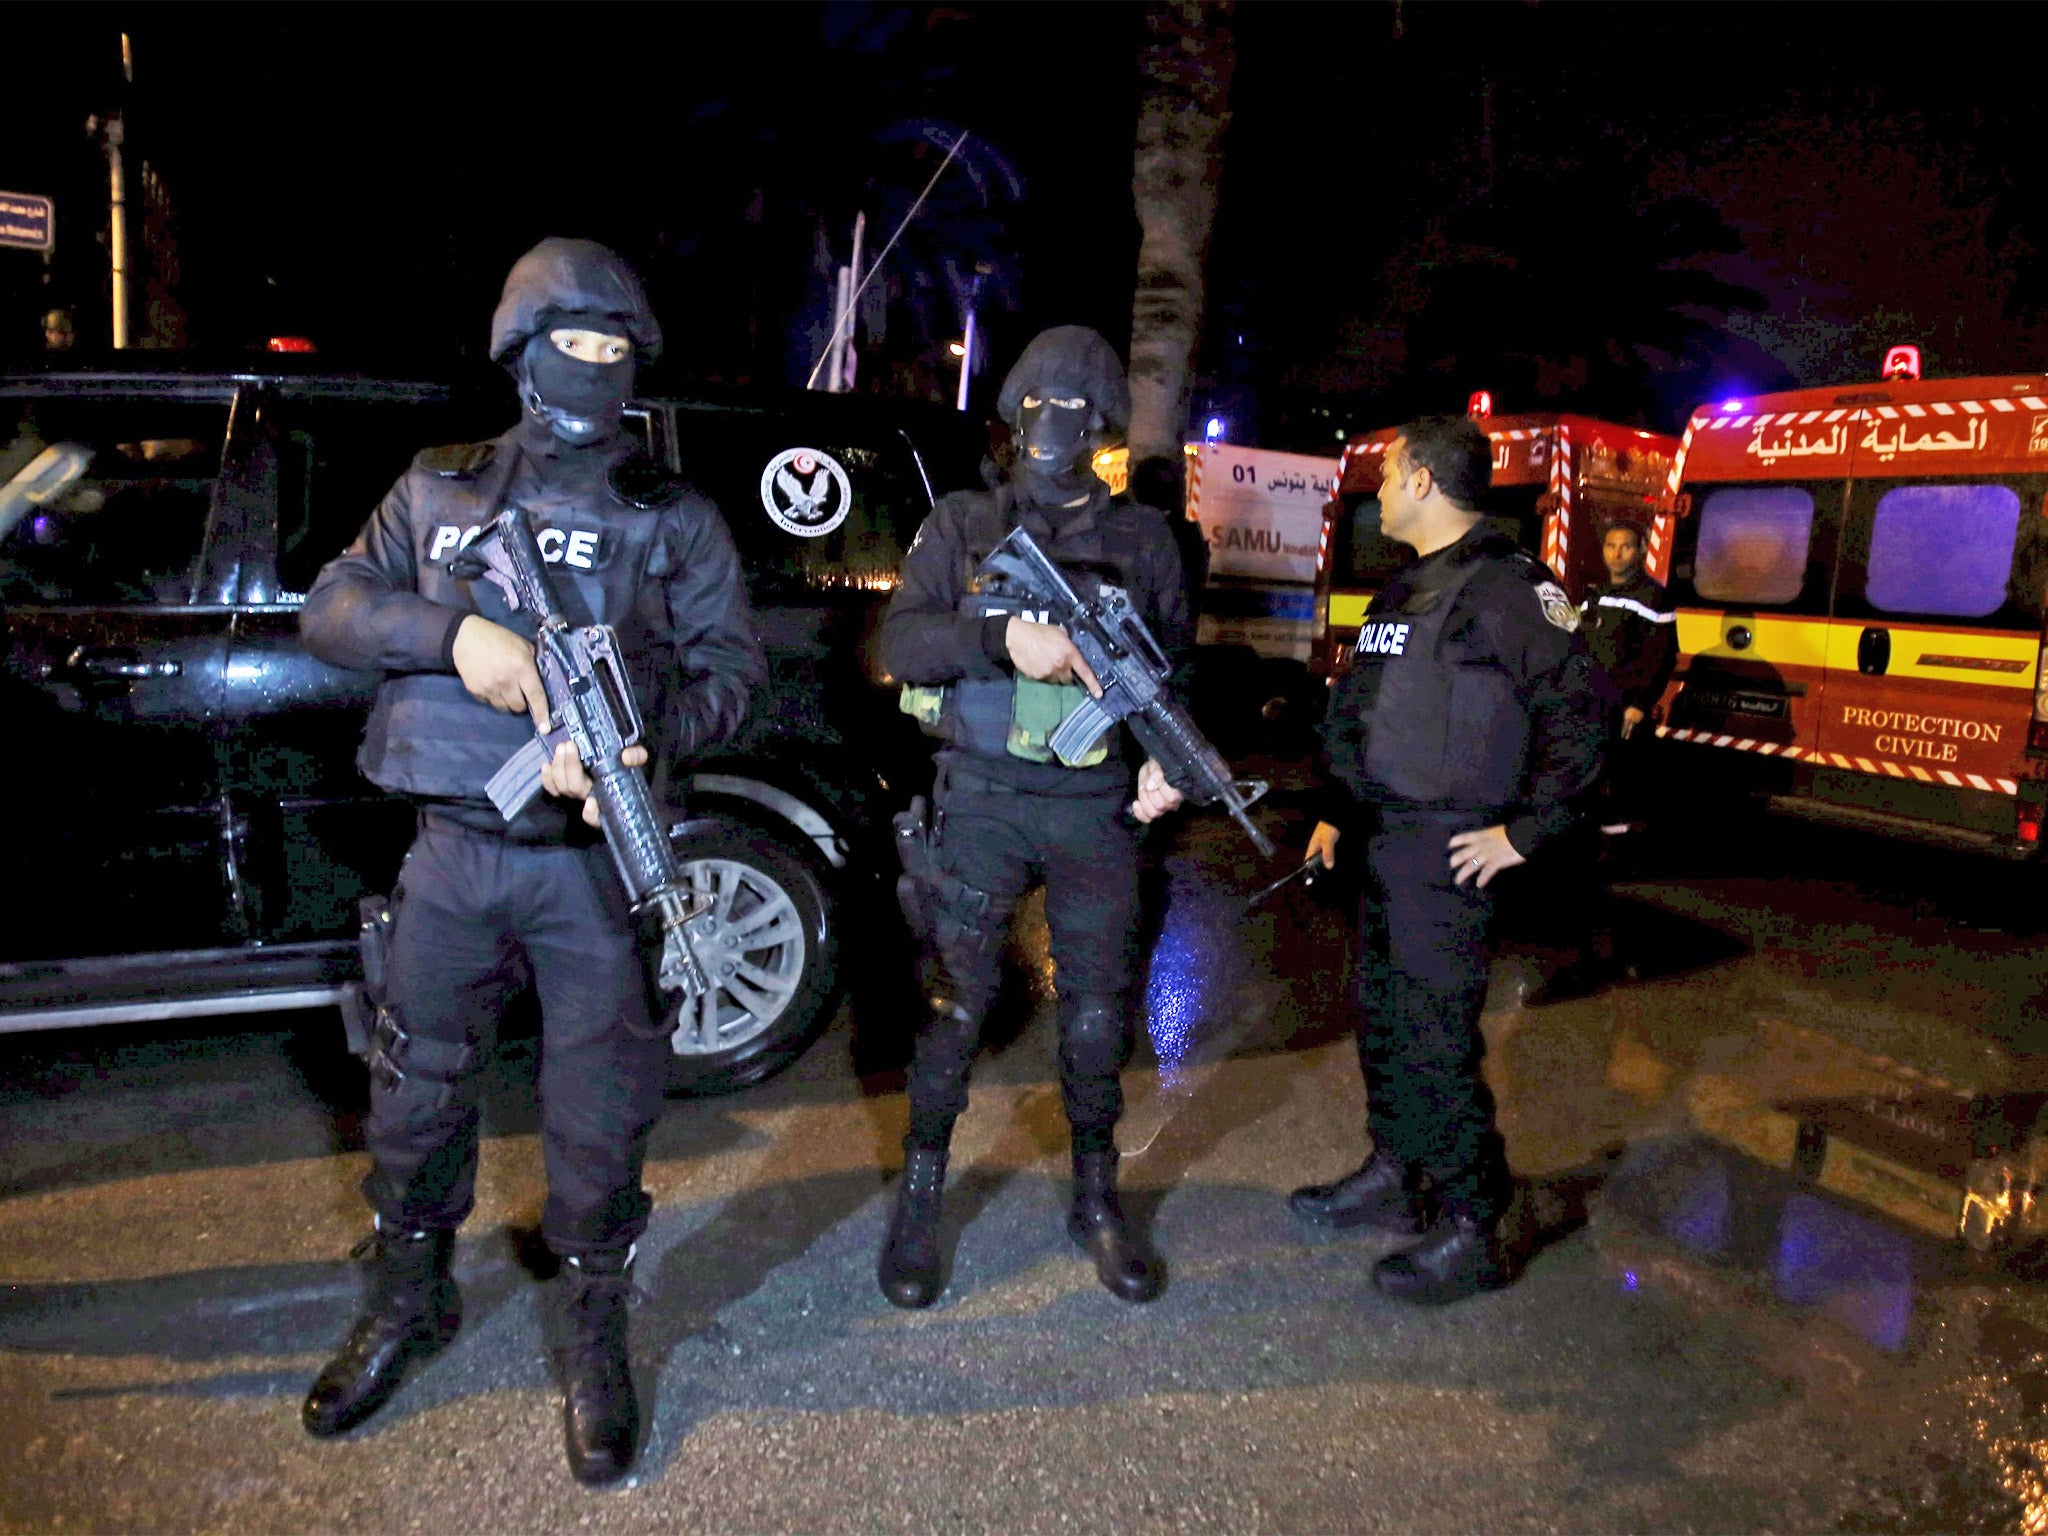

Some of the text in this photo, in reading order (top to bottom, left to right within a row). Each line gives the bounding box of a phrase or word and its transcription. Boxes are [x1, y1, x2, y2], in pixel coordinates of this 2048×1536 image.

[1747, 417, 1988, 466] الحماية المدنية
[1232, 464, 1256, 484] 01
[1211, 525, 1281, 553] SAMU
[1842, 706, 2002, 743] PROTECTION
[1875, 735, 1958, 762] CIVILE
